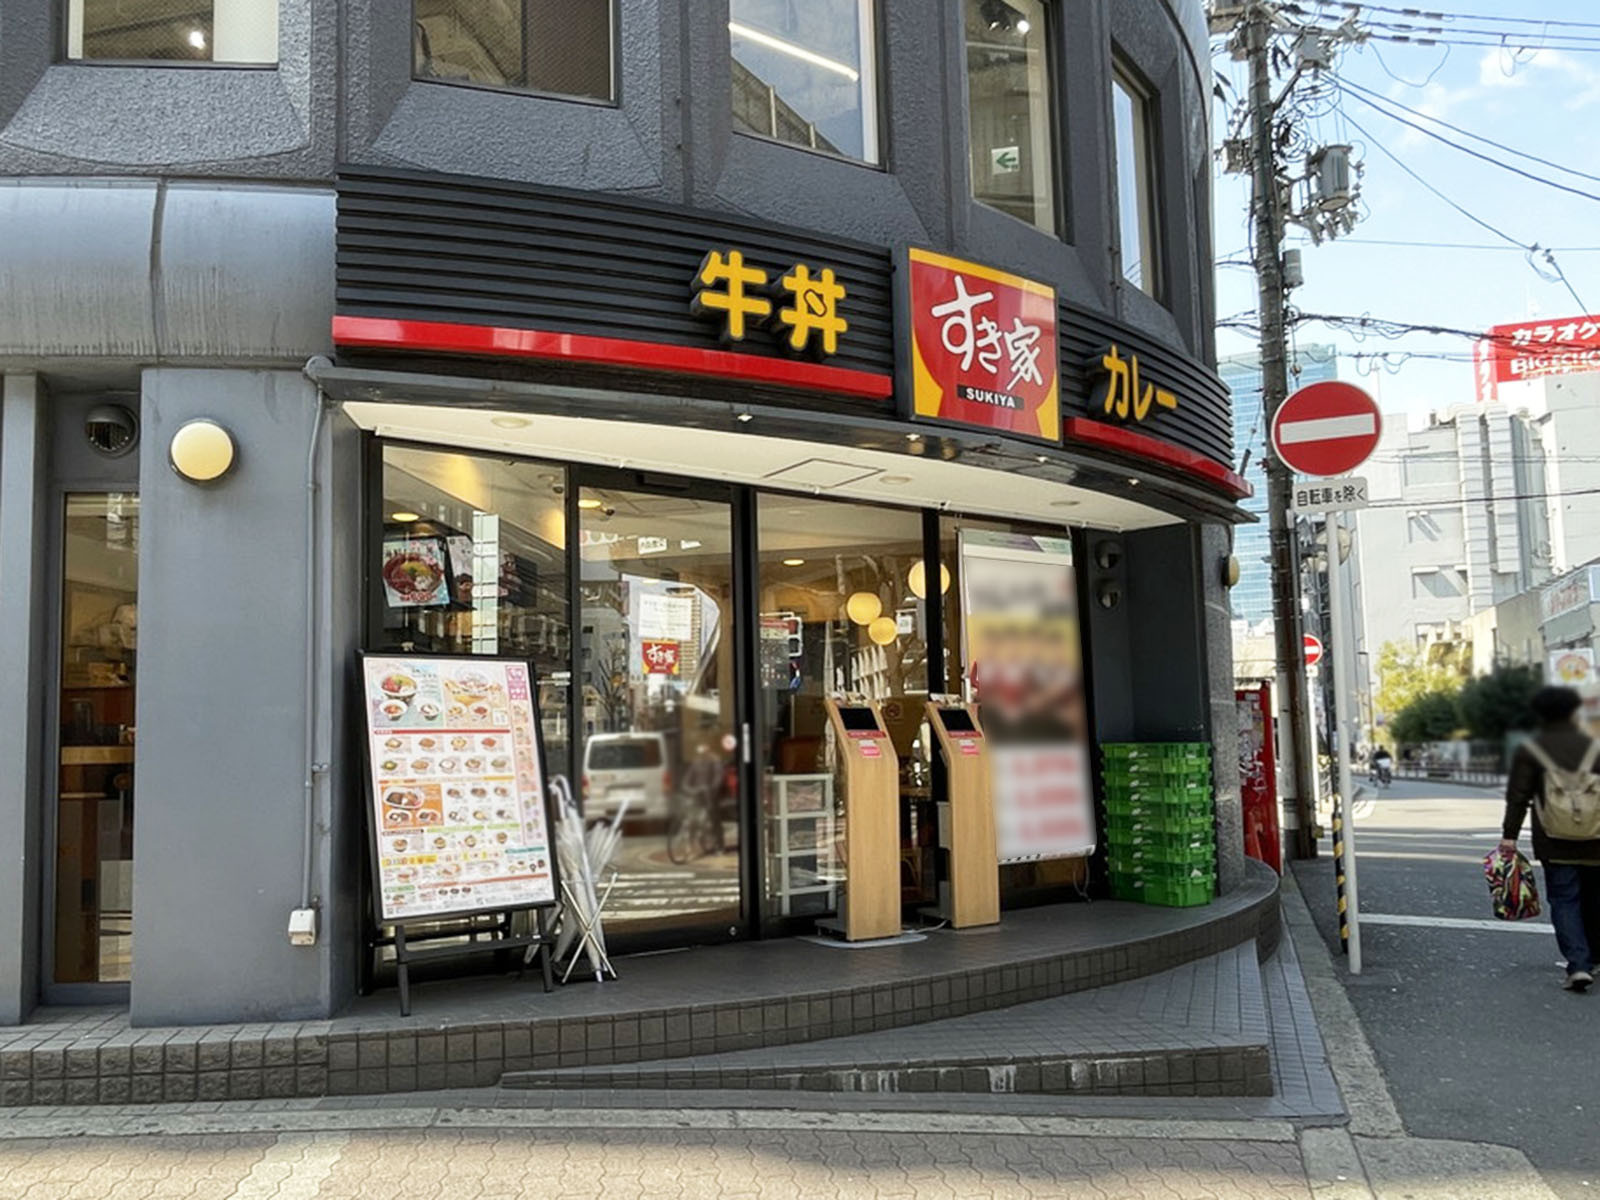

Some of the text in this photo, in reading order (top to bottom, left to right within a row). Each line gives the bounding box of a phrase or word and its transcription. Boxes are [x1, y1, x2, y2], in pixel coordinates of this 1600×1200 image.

[700, 250, 848, 355] 牛丼
[931, 275, 1043, 391] すき家
[966, 387, 1016, 408] SUKIYA
[1103, 344, 1177, 421] カレー
[1297, 484, 1365, 507] 自転車を除く
